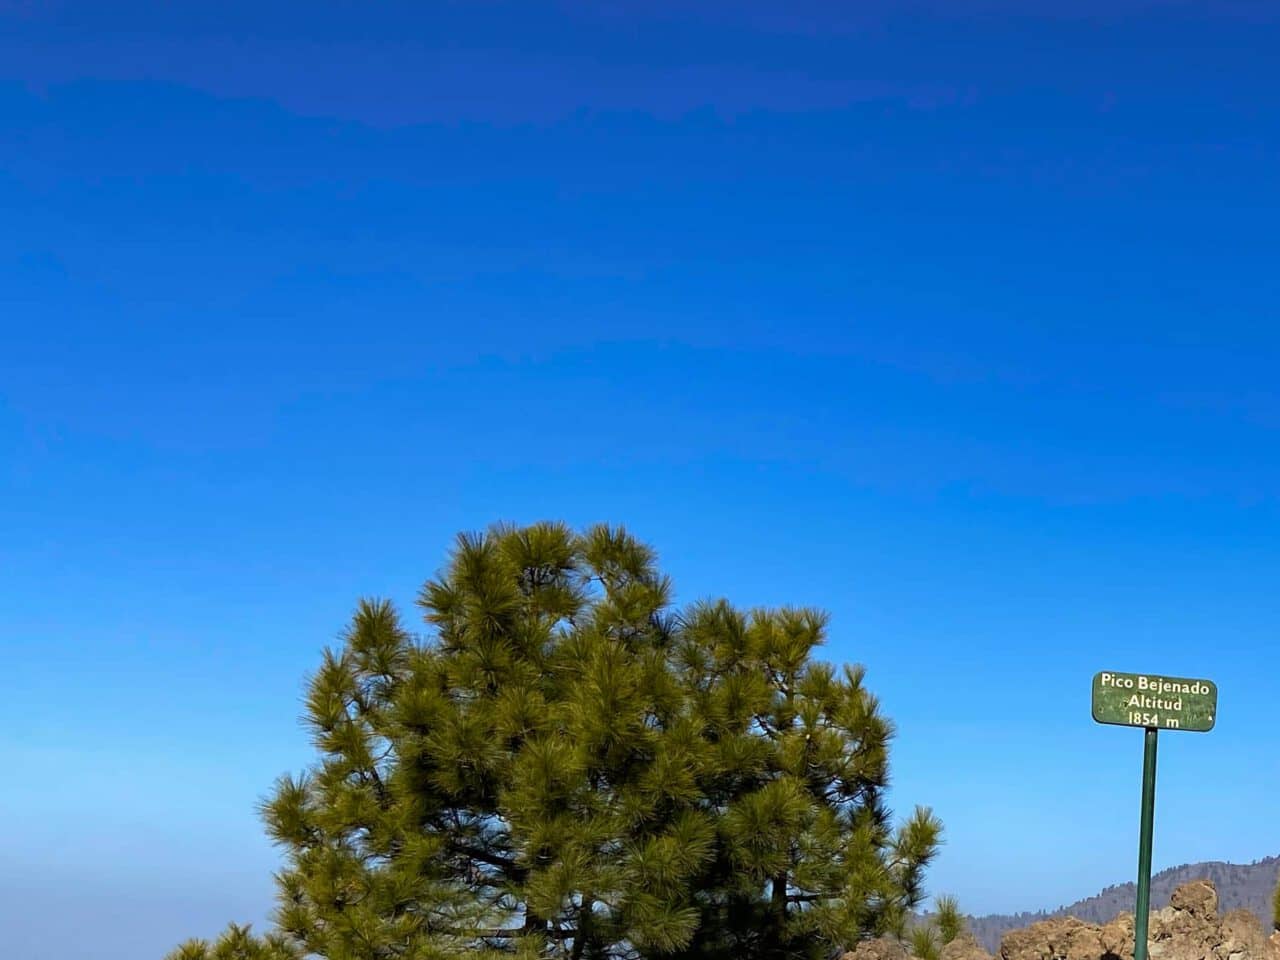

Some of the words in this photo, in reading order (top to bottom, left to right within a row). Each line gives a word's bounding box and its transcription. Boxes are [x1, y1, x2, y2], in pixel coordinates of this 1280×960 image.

[1101, 673, 1134, 688] Pico
[1138, 676, 1210, 695] Bejenado
[1128, 695, 1182, 711] Altitud
[1129, 712, 1158, 726] 1854
[1166, 718, 1179, 728] m
